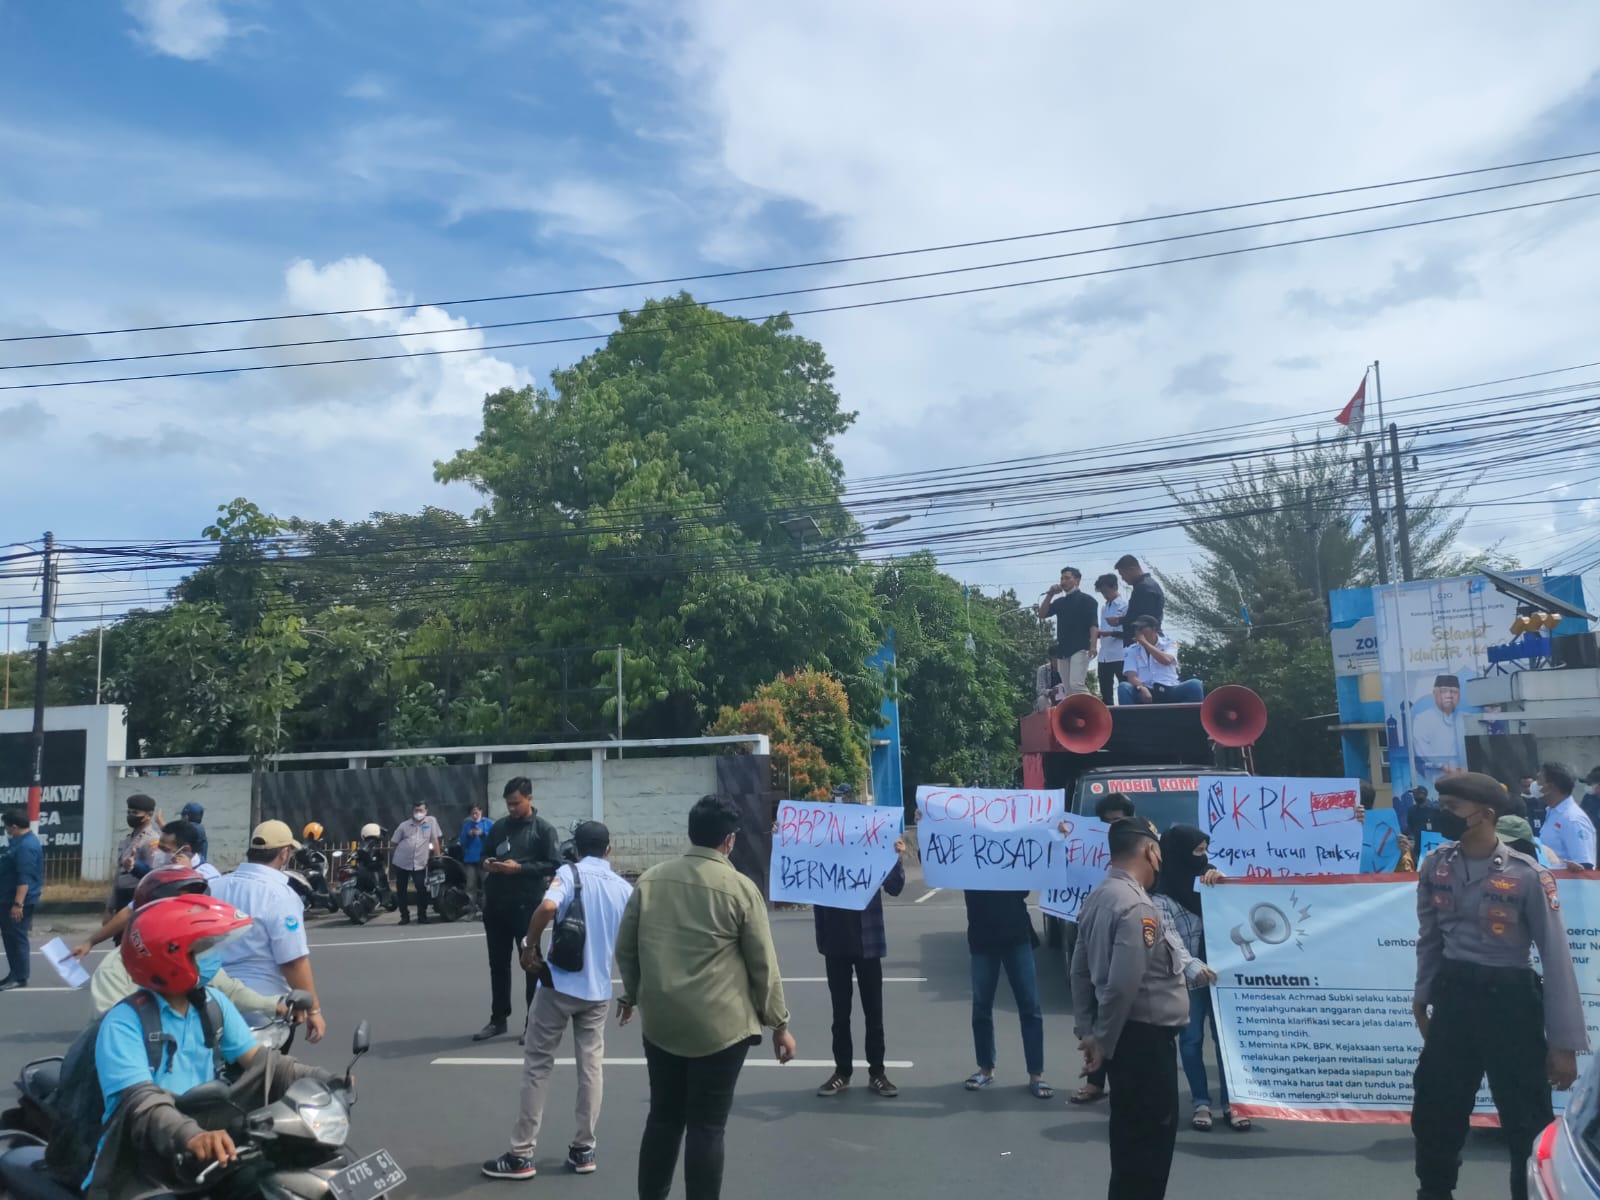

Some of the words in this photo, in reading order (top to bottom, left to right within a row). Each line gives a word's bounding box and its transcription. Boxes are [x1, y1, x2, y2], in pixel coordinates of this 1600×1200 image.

[1107, 778, 1157, 793] MOBIL
[40, 785, 82, 802] AKYAT
[925, 791, 1053, 829] COPOT!!!
[1232, 784, 1305, 832] KPK
[1267, 841, 1307, 859] turun
[1234, 973, 1310, 987] Tuntutan
[1242, 993, 1286, 1001] Mendesak
[1288, 993, 1327, 1001] Achmad
[1328, 994, 1354, 1002] Subki
[1356, 994, 1384, 1003] selaku
[1235, 1005, 1318, 1014] menyalahgunakan
[1320, 1007, 1362, 1016] anggaran
[1364, 1006, 1387, 1014] dana
[1246, 1016, 1286, 1025] Meminta
[1287, 1017, 1330, 1026] klarifikasi
[1362, 1019, 1382, 1028] jelas
[1383, 1020, 1413, 1028] dalam
[1238, 1029, 1279, 1038] tumpang
[1248, 1041, 1288, 1050] Meminta
[1336, 1043, 1381, 1053] Kejaksaan
[1382, 1044, 1405, 1052] serta
[1241, 1053, 1290, 1061] melakukan
[1293, 1055, 1336, 1064] pekerjaan
[1338, 1055, 1384, 1064] revitalisasi
[1252, 1066, 1316, 1076] Mengingatkan
[1318, 1067, 1350, 1076] kepada
[1351, 1068, 1393, 1077] siapapun
[1273, 1079, 1298, 1087] maka
[1300, 1079, 1325, 1087] harus
[1326, 1080, 1343, 1088] taat
[1345, 1080, 1362, 1088] dan
[1364, 1081, 1396, 1089] tunduk
[1270, 1090, 1286, 1098] dan
[1288, 1091, 1339, 1101] melengkapi
[1340, 1092, 1373, 1100] seluruh
[330, 1179, 344, 1194] L
[346, 1162, 374, 1186] 4776
